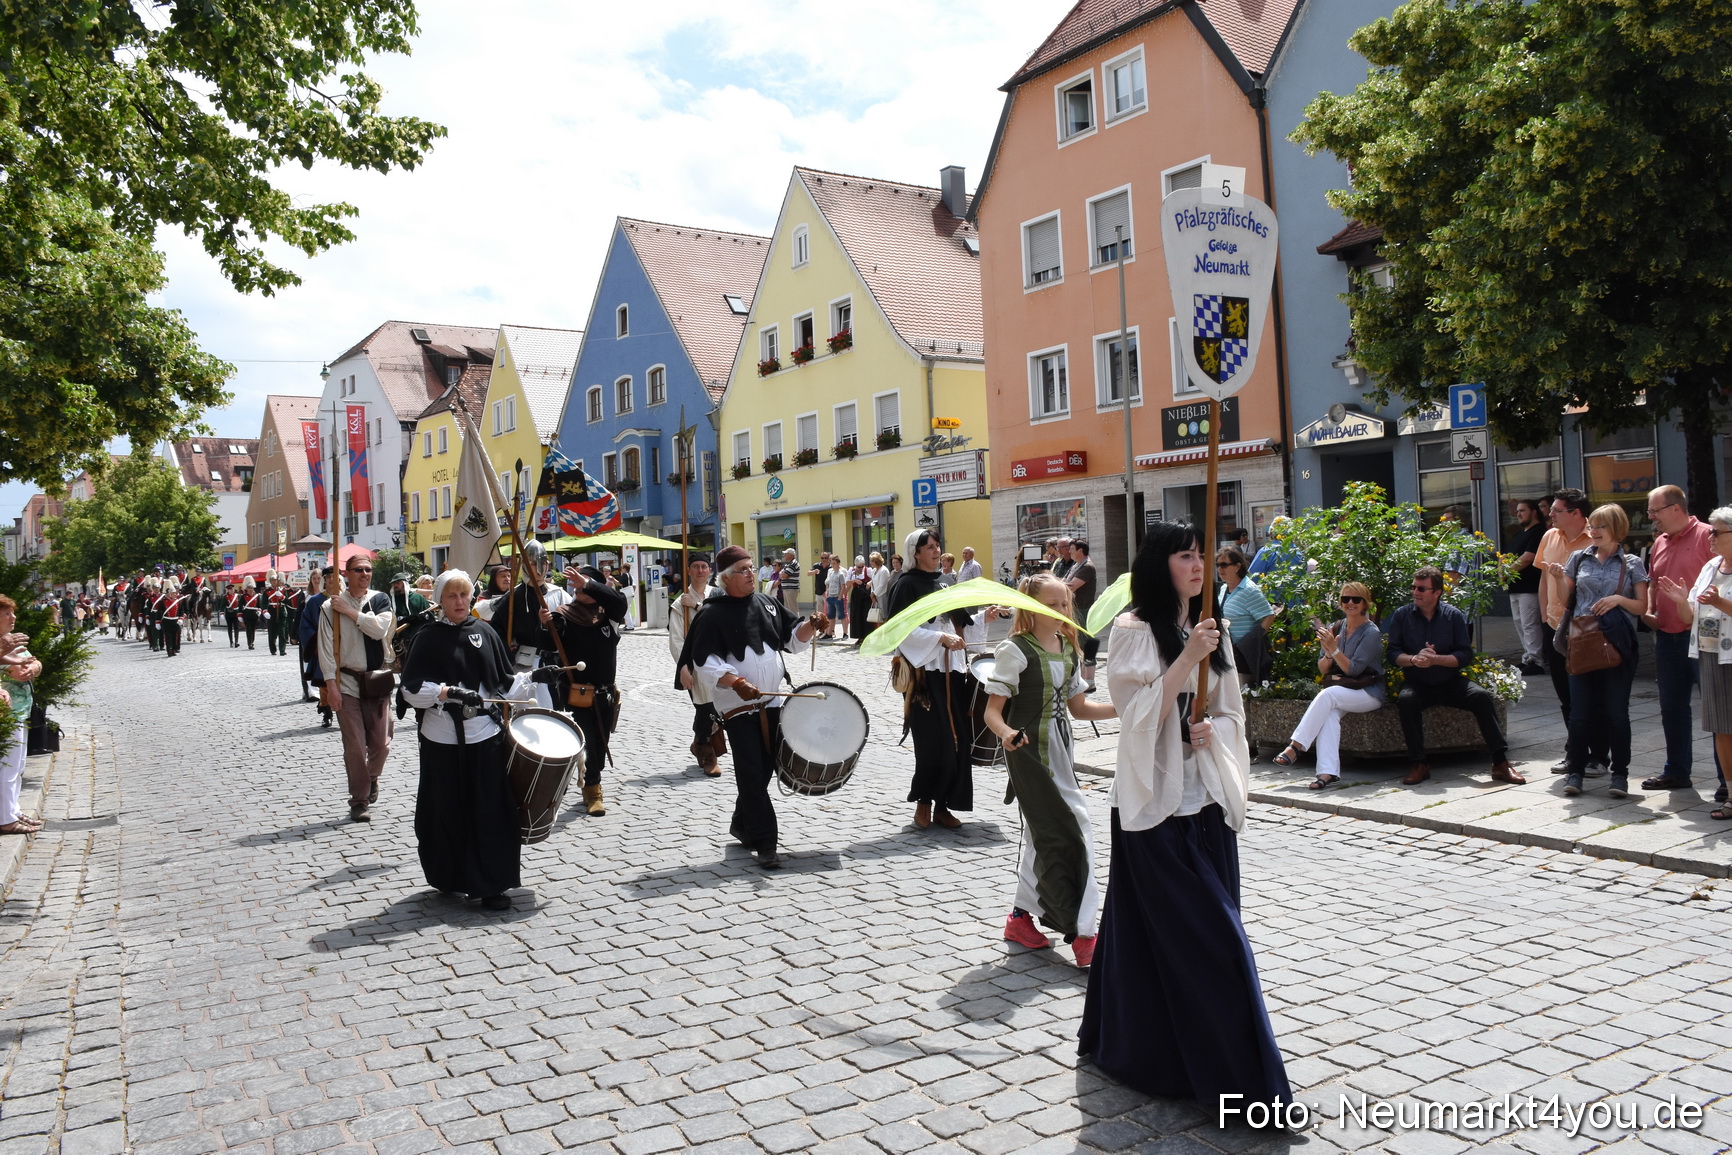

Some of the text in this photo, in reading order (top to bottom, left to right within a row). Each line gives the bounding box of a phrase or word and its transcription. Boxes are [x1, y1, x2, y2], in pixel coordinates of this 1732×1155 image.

[1221, 179, 1231, 198] 5
[1174, 206, 1269, 239] Pfalzgräfisches
[1208, 238, 1238, 255] Gefolge
[1193, 252, 1251, 277] Neumarkt
[1167, 400, 1231, 421] NIEßLBK
[1457, 389, 1478, 423] P
[937, 419, 951, 428] KINO
[1308, 423, 1369, 442] MÜHLBAUER
[1175, 438, 1191, 446] OBST
[1198, 433, 1226, 443] GESE
[1068, 454, 1083, 466] DER
[432, 468, 449, 483] HOTEL
[951, 470, 967, 482] KINO
[977, 451, 985, 495] KINO
[1012, 464, 1027, 478] DER
[1301, 469, 1311, 480] 16
[917, 482, 932, 504] P
